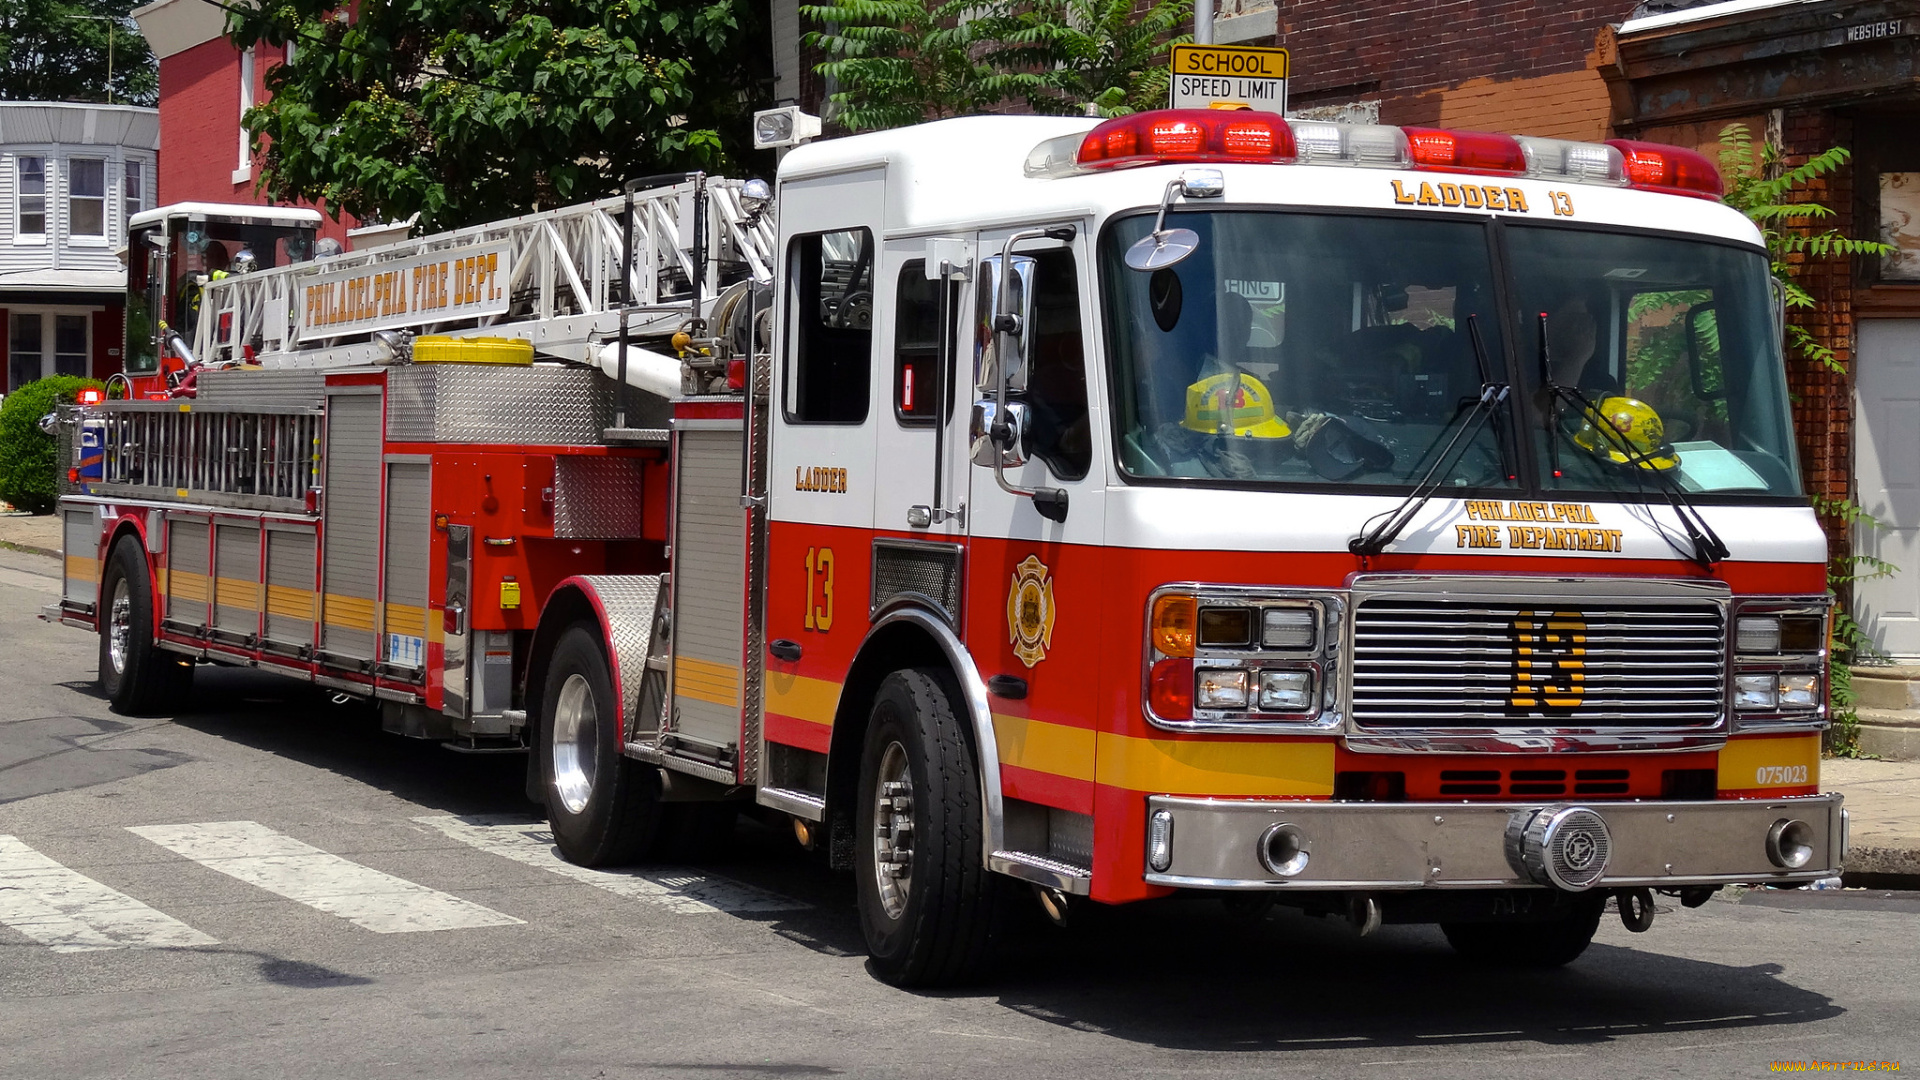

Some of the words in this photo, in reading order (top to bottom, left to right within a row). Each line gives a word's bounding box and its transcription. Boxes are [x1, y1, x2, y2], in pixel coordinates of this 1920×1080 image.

[1847, 21, 1887, 42] WEBSTER
[1889, 19, 1902, 36] ST
[1188, 52, 1272, 74] SCHOOL
[1181, 77, 1231, 97] SPEED
[1239, 80, 1277, 99] LIMIT
[1391, 179, 1529, 213] LADDER
[1549, 190, 1574, 217] 13
[306, 270, 407, 327] PHILADELPHIA
[412, 262, 448, 312] FIRE
[454, 252, 502, 307] DEPT.
[795, 465, 848, 494] LADDER
[1464, 500, 1600, 525] PHILADELPHIA
[1455, 525, 1502, 549] FIRE
[1507, 526, 1623, 553] DEPARTMENT
[804, 546, 834, 633] 13
[1507, 610, 1587, 712] 13
[1756, 764, 1807, 785] 075023
